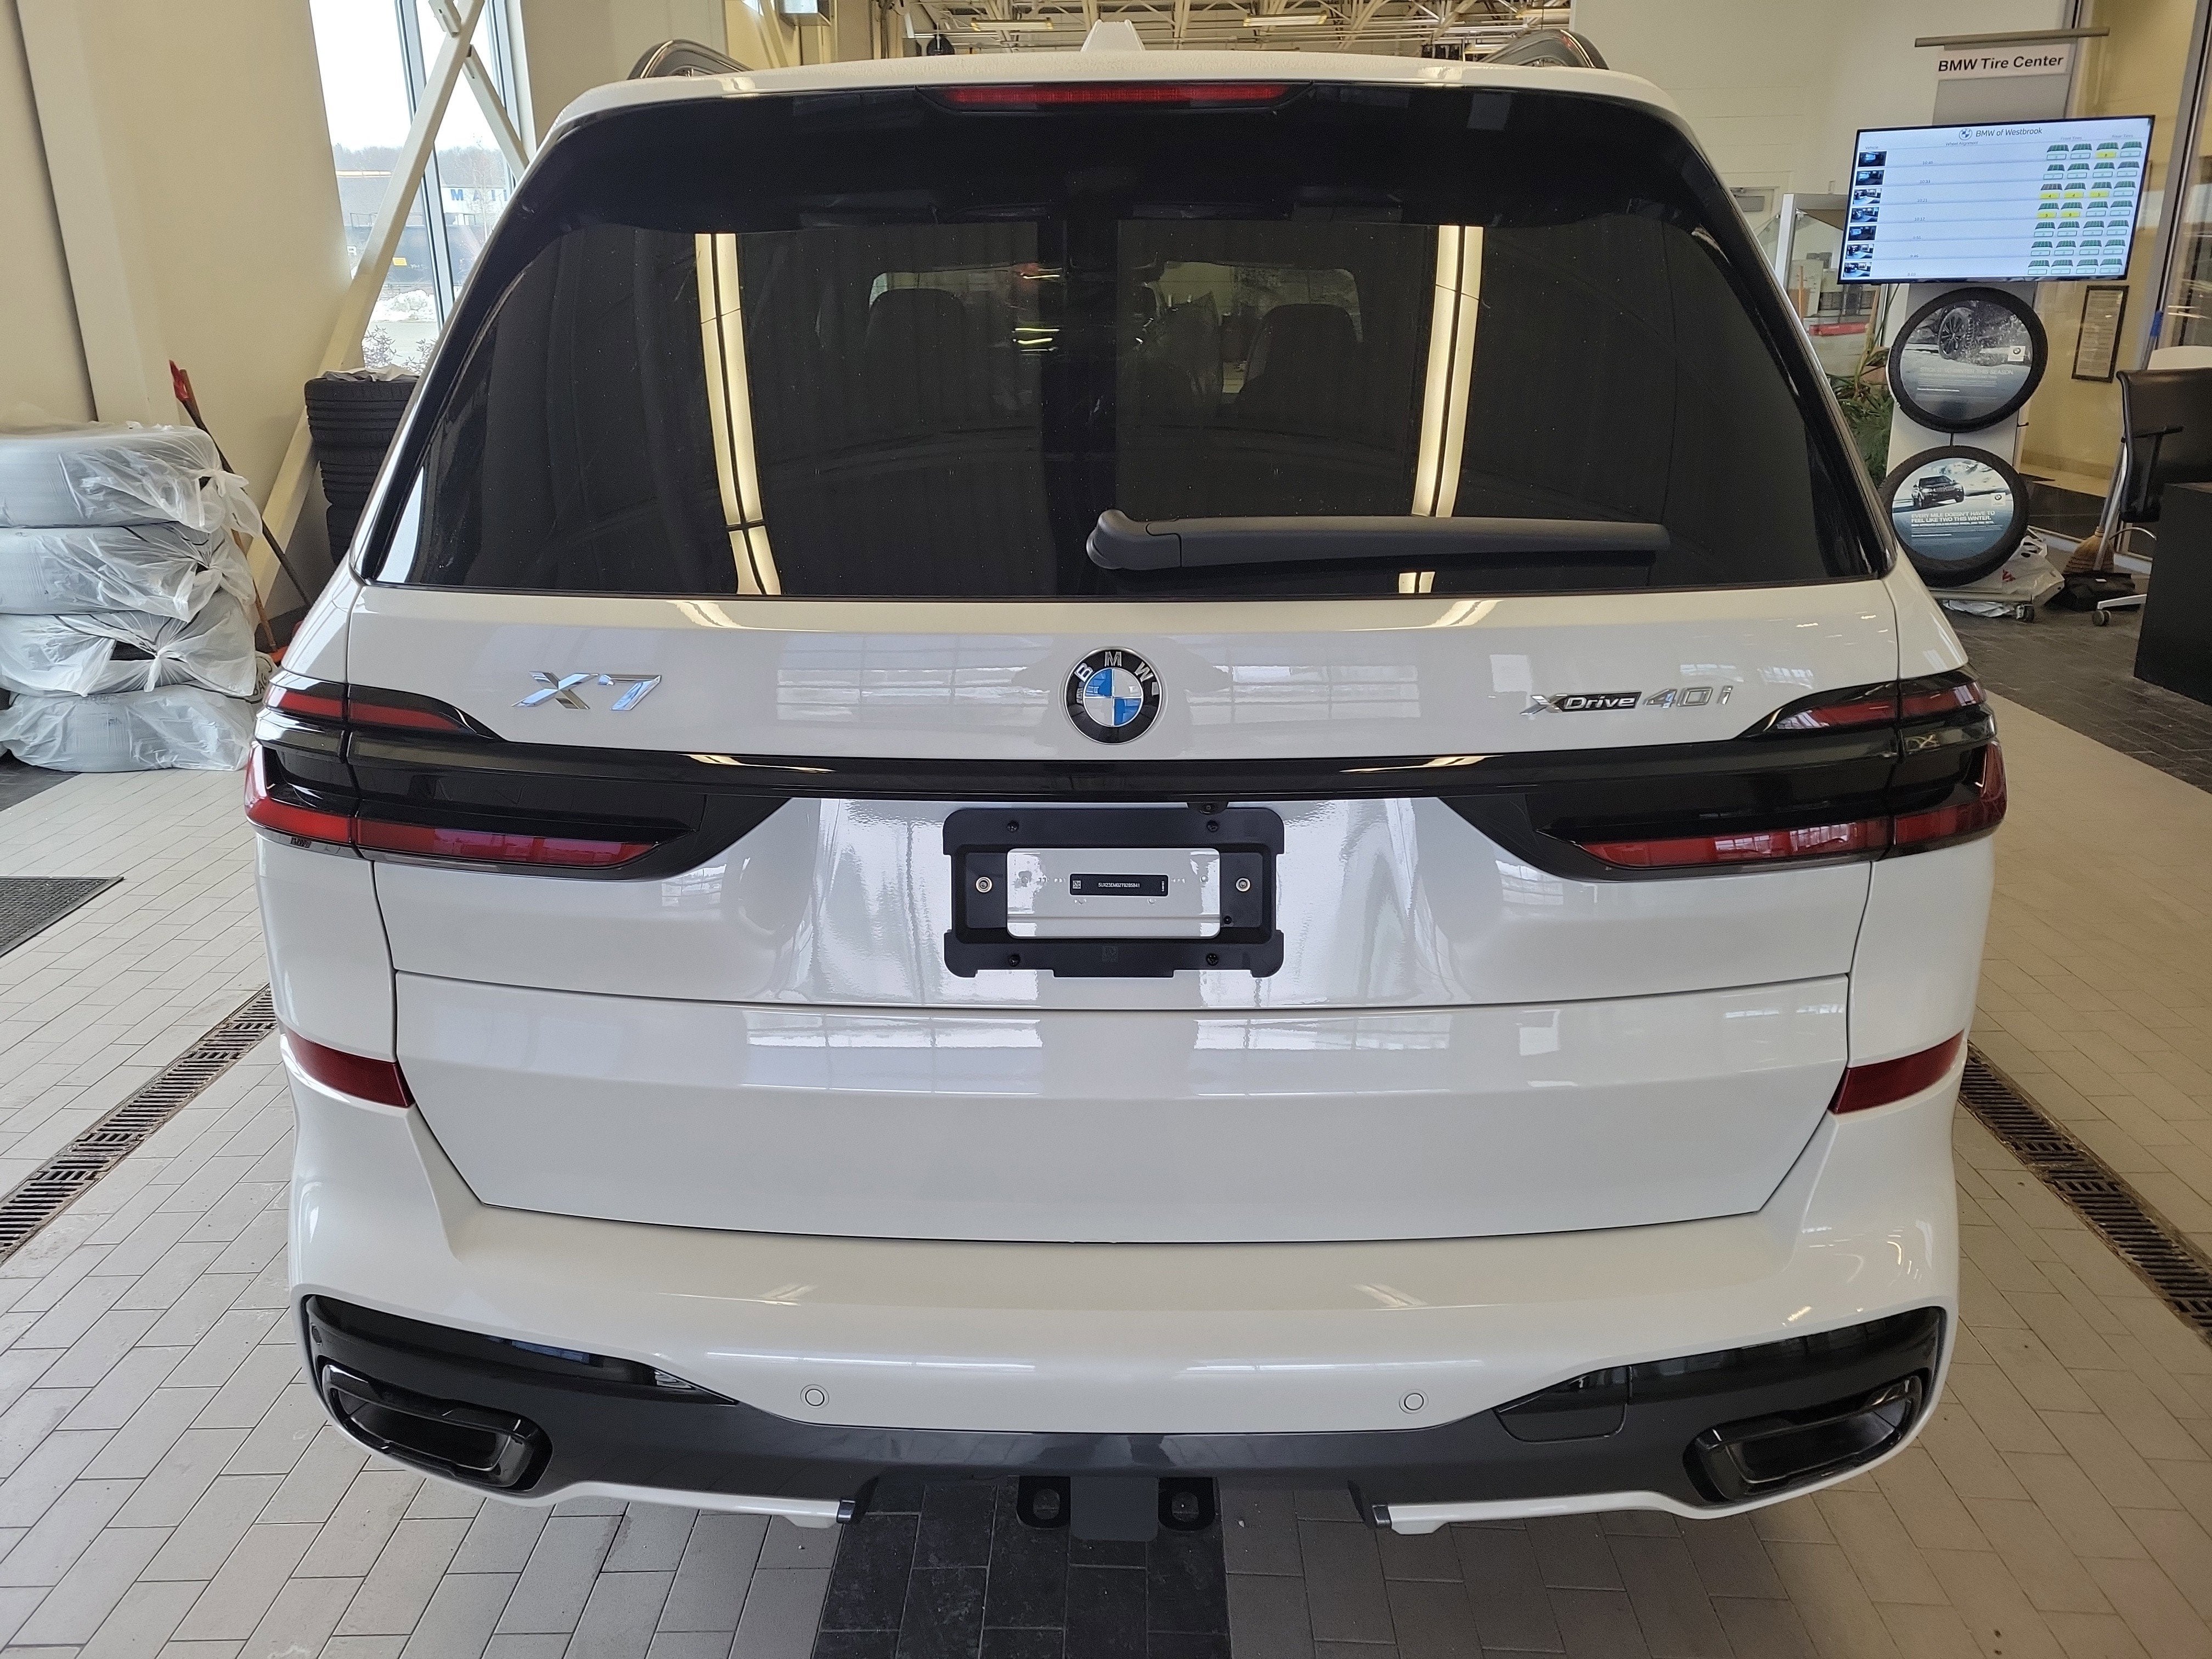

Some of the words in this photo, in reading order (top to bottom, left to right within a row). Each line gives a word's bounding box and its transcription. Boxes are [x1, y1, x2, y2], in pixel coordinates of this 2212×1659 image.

[1938, 59, 1977, 72] BMW
[1981, 58, 2008, 69] Tire
[2013, 56, 2064, 67] Center
[2005, 127, 2042, 136] Westbrook
[1074, 651, 1154, 682] BMW
[511, 671, 662, 711] X7
